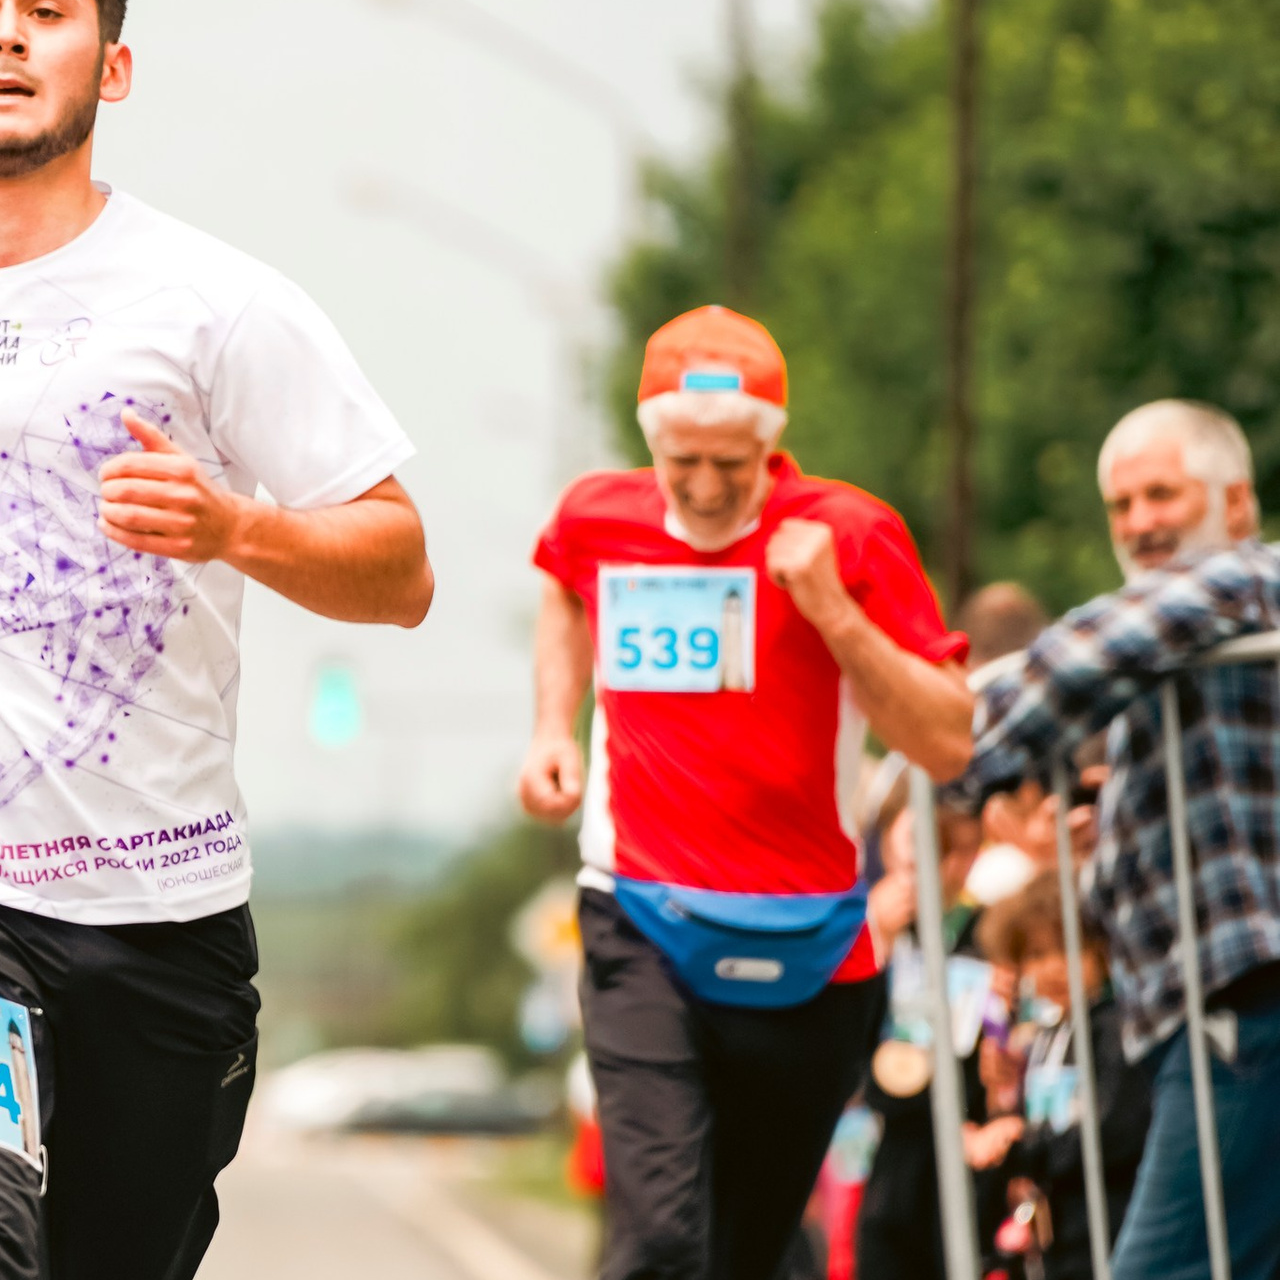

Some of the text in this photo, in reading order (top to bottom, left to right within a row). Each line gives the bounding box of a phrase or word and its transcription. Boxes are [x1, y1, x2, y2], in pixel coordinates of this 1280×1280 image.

[618, 626, 719, 669] 539
[0, 835, 92, 860] ЛЕТНЯЯ
[96, 810, 235, 852] САРТАКИАДА
[160, 846, 202, 868] 2022
[204, 833, 243, 857] ГОДА
